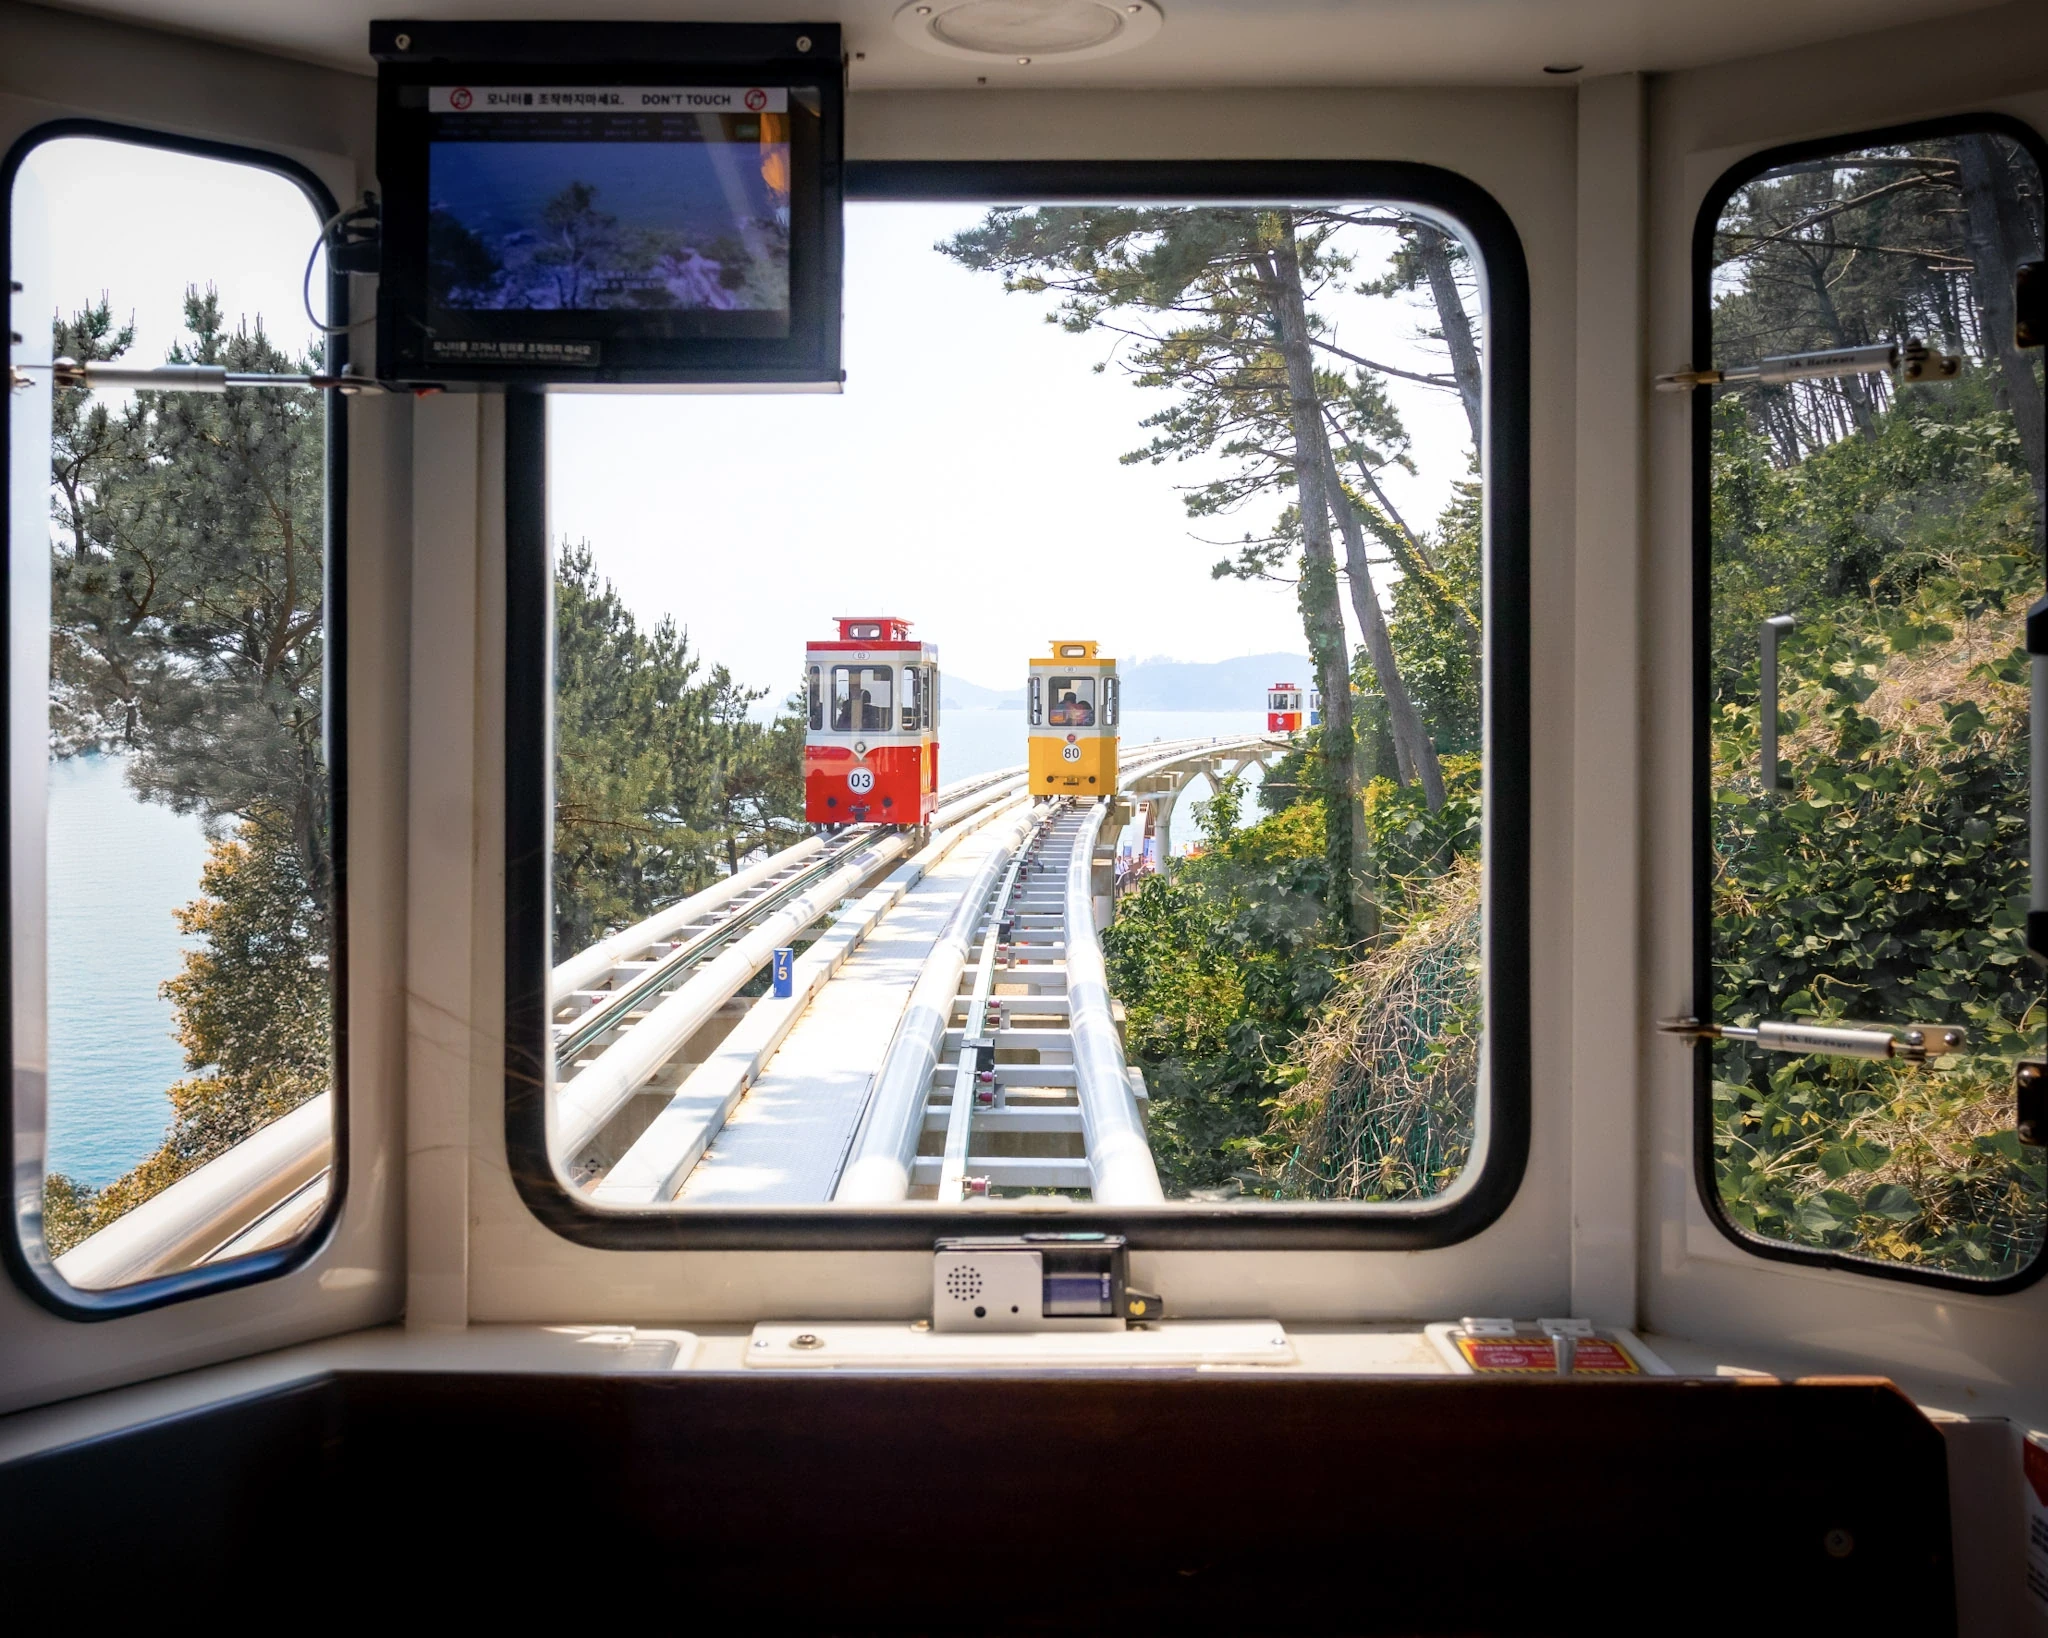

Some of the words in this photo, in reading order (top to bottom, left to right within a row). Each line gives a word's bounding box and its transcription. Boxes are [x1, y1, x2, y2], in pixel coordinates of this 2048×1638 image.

[487, 92, 533, 106] 모니터를
[538, 92, 625, 106] 조작하지마세요.
[641, 94, 682, 106] DON'T
[687, 94, 731, 106] TOUCH
[1064, 747, 1080, 759] 80
[851, 773, 871, 788] 03
